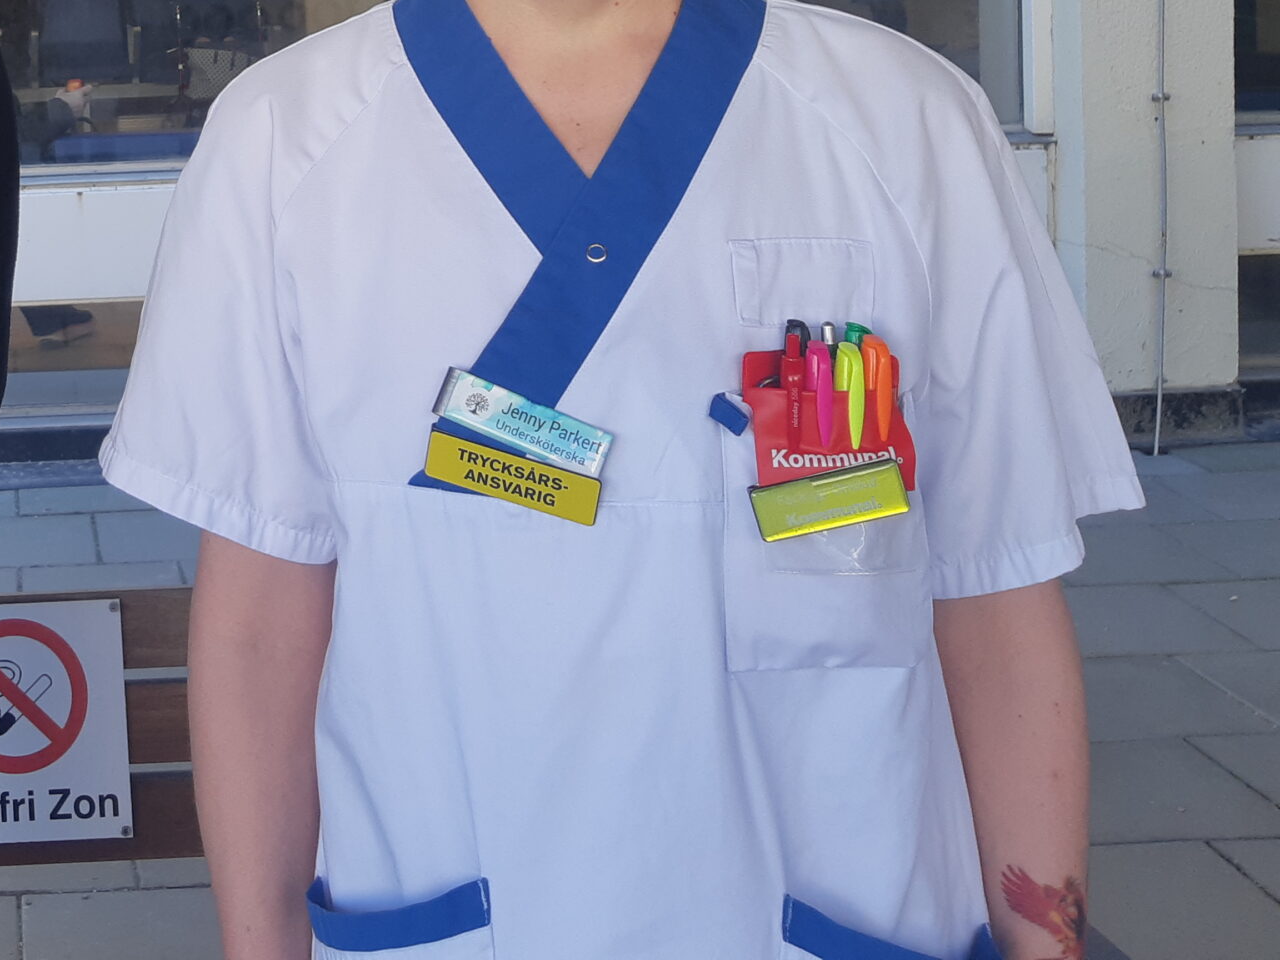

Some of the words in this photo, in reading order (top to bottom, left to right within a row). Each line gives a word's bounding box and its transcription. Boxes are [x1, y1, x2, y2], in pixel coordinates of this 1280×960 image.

[495, 419, 585, 466] Undersköterska
[501, 402, 546, 433] Jenny
[548, 420, 602, 455] Parkert
[458, 448, 569, 491] TRYCKSÅRS-
[464, 469, 556, 507] ANSVARIG
[48, 789, 119, 820] Zon
